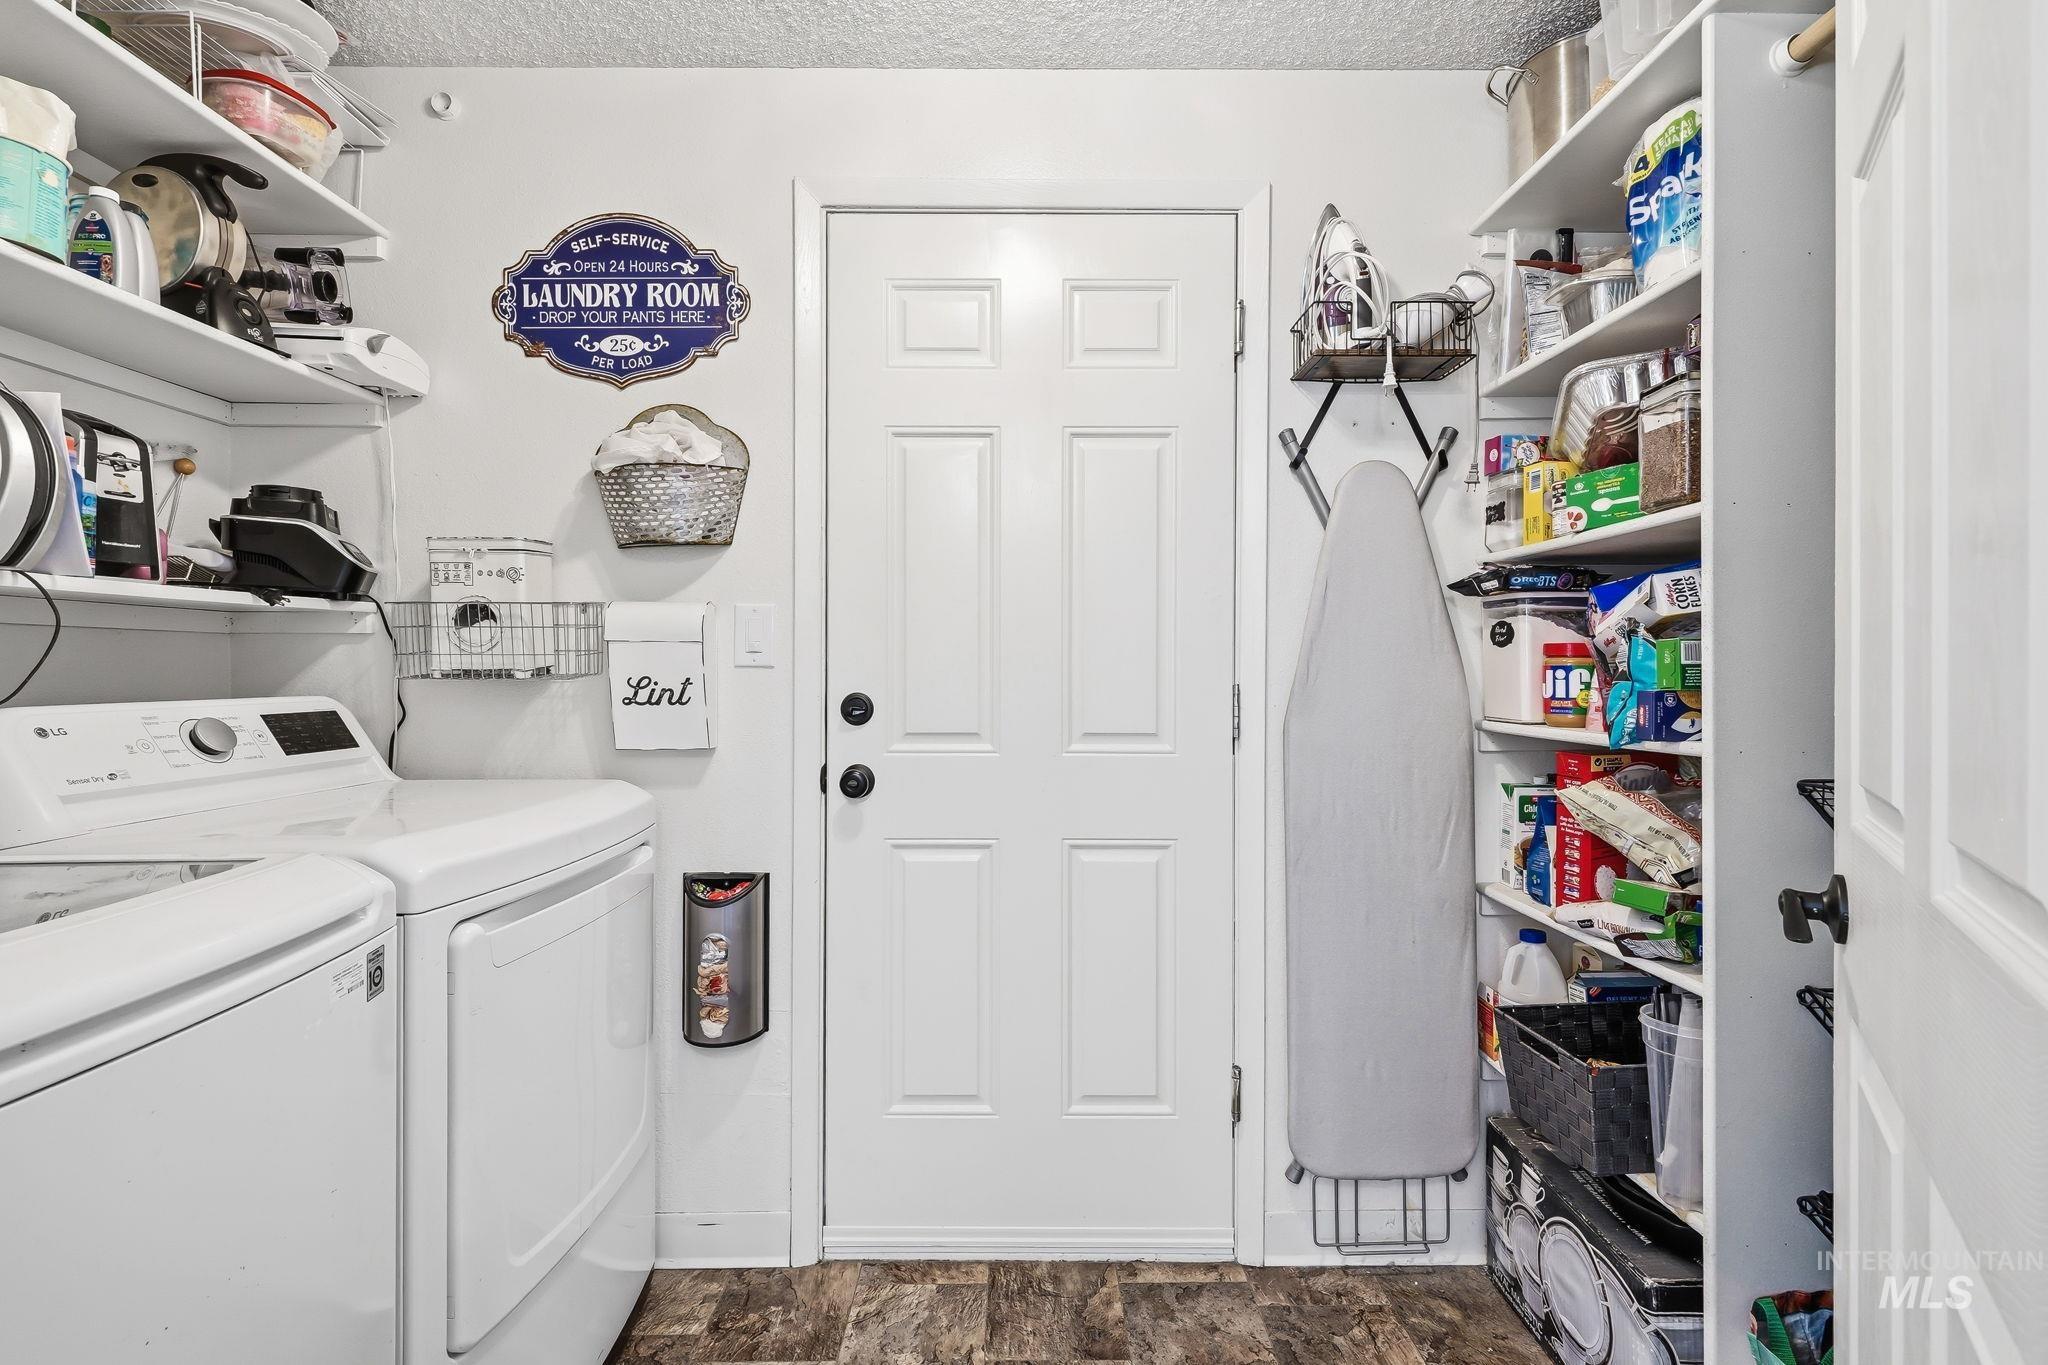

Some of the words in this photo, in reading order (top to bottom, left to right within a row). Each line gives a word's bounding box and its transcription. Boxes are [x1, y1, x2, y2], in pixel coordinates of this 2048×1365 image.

[570, 233, 670, 254] SELF-SERVICE
[573, 260, 606, 273] OPEN
[609, 260, 626, 273] 24
[629, 260, 669, 273] HOURS
[522, 282, 639, 308] LAUNDRY
[646, 282, 720, 308] ROOM
[539, 310, 577, 324] DROP
[582, 310, 617, 324] YOUR
[622, 310, 666, 324] PANTS
[670, 310, 705, 324] HERE
[591, 354, 614, 370] PER
[621, 354, 653, 370] LOAD
[1671, 578, 1691, 610] CORN
[1683, 575, 1702, 608] FLAKES
[622, 675, 694, 706] Lint
[49, 727, 68, 736] LG
